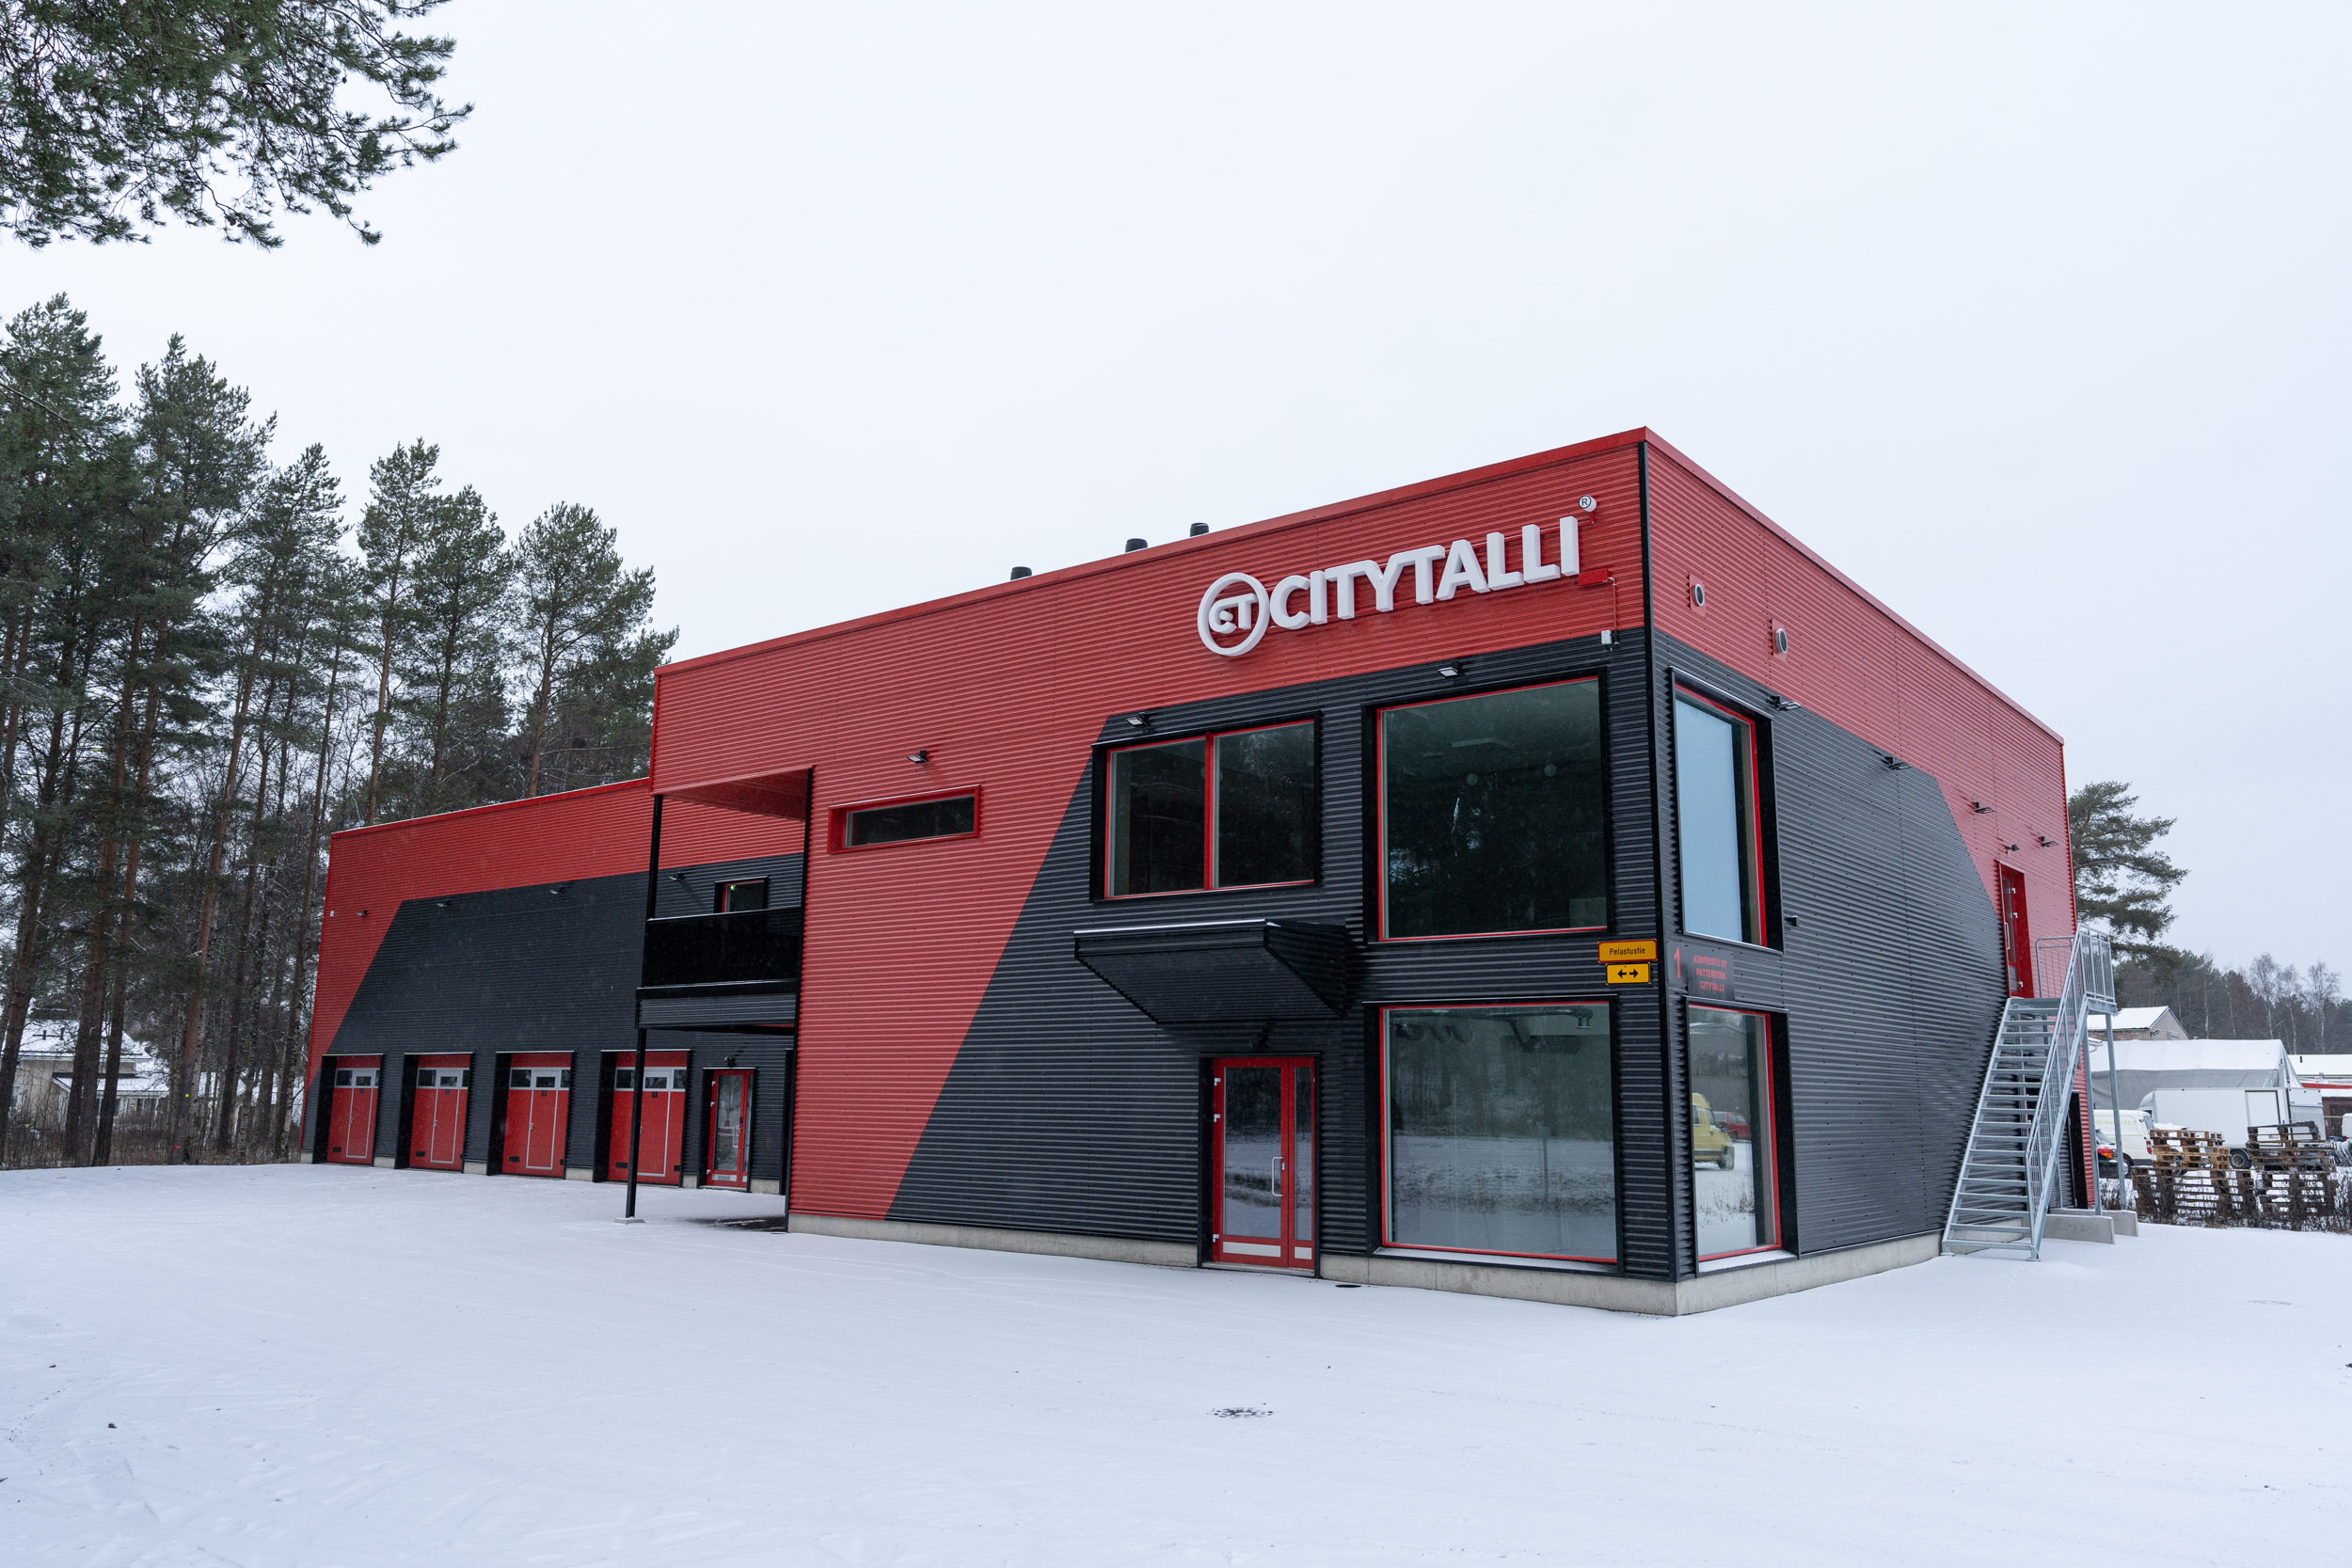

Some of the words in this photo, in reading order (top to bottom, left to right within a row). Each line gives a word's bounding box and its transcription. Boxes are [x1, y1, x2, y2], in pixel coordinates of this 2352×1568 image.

[1270, 515, 1581, 630] CITYTALLI
[1609, 946, 1646, 956] Pelastustie
[1673, 947, 1681, 979] 1
